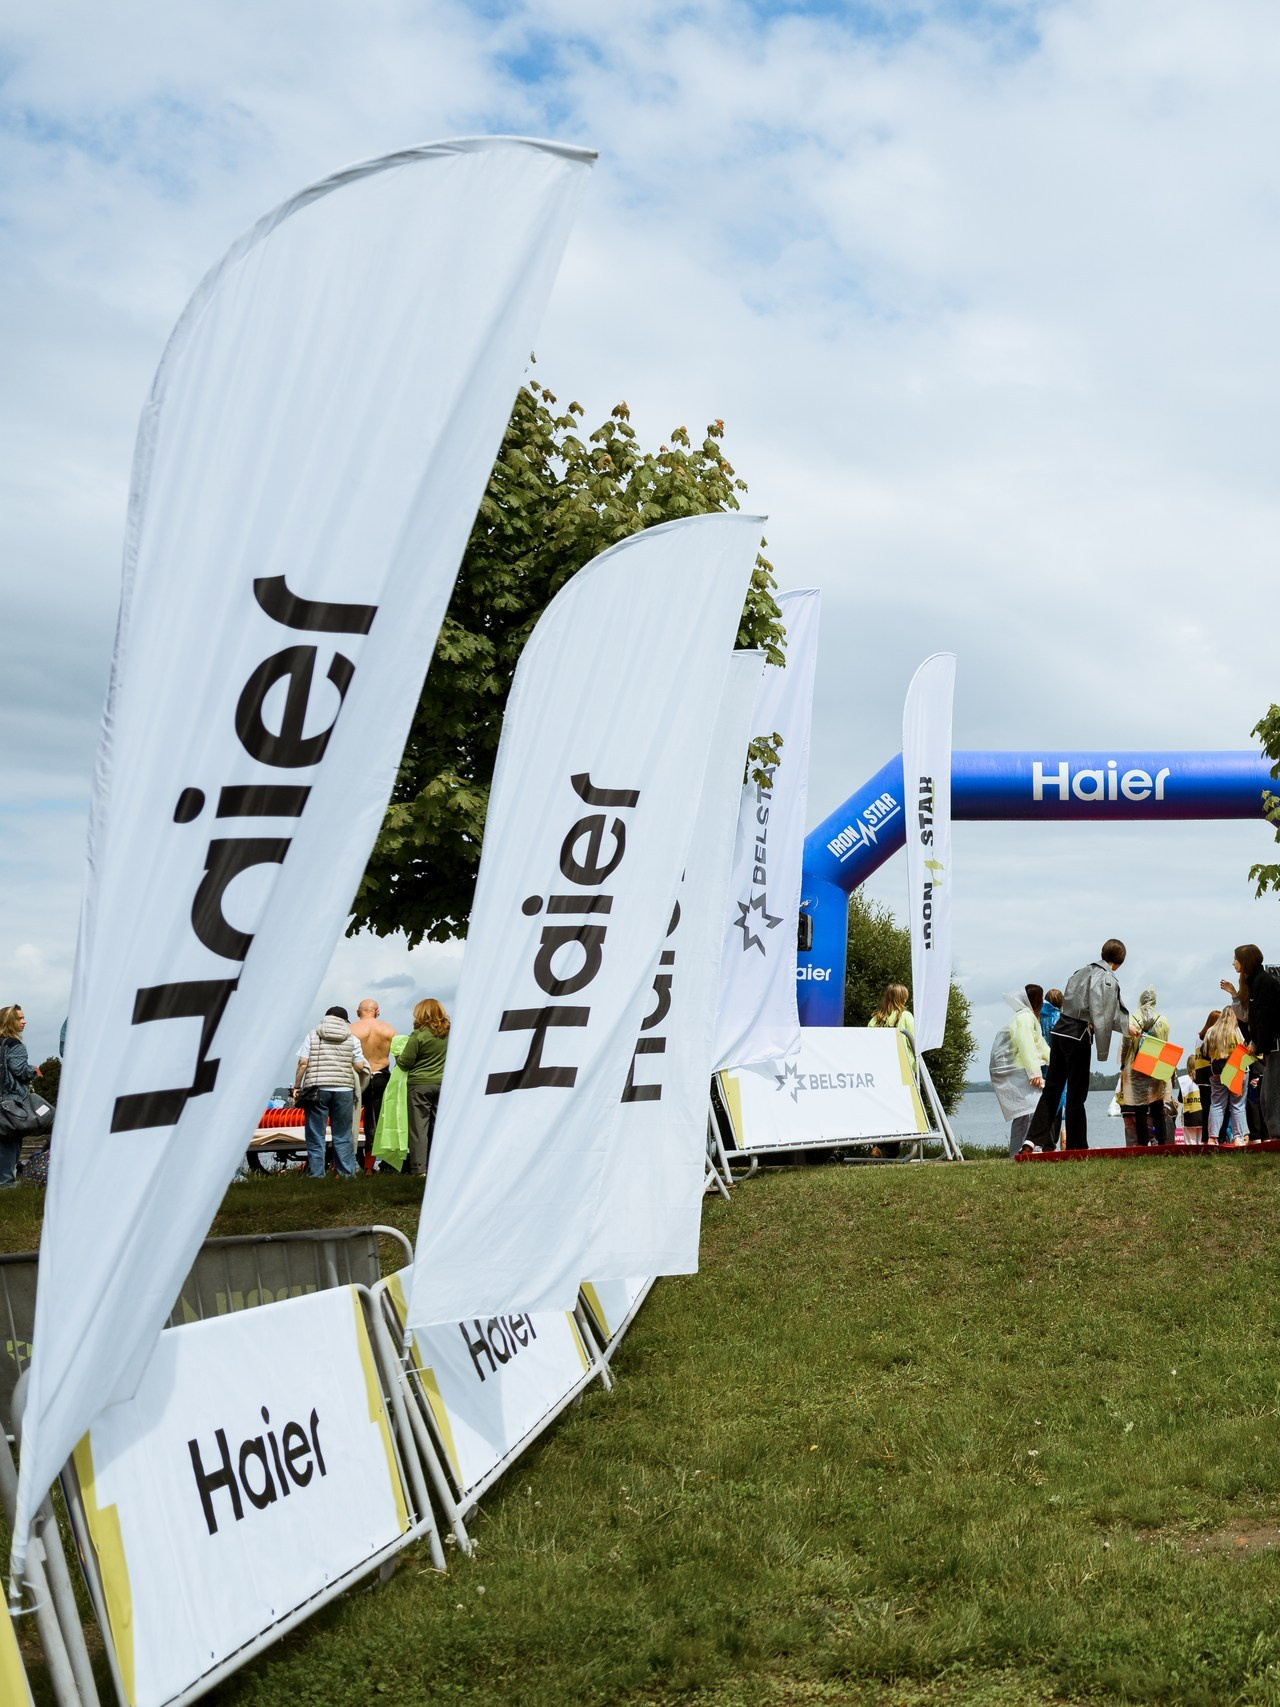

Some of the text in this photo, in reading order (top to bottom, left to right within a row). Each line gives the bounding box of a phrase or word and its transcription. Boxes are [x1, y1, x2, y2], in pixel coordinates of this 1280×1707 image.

[752, 744, 776, 885] BELSTA
[918, 776, 934, 846] STAR
[1032, 760, 1170, 801] Haier
[110, 575, 378, 1133] Haier
[826, 792, 897, 858] IRON STAR
[485, 772, 641, 1095] Haier
[795, 963, 832, 981] aier
[809, 1072, 876, 1090] BELSTAR
[187, 1405, 327, 1536] Haier
